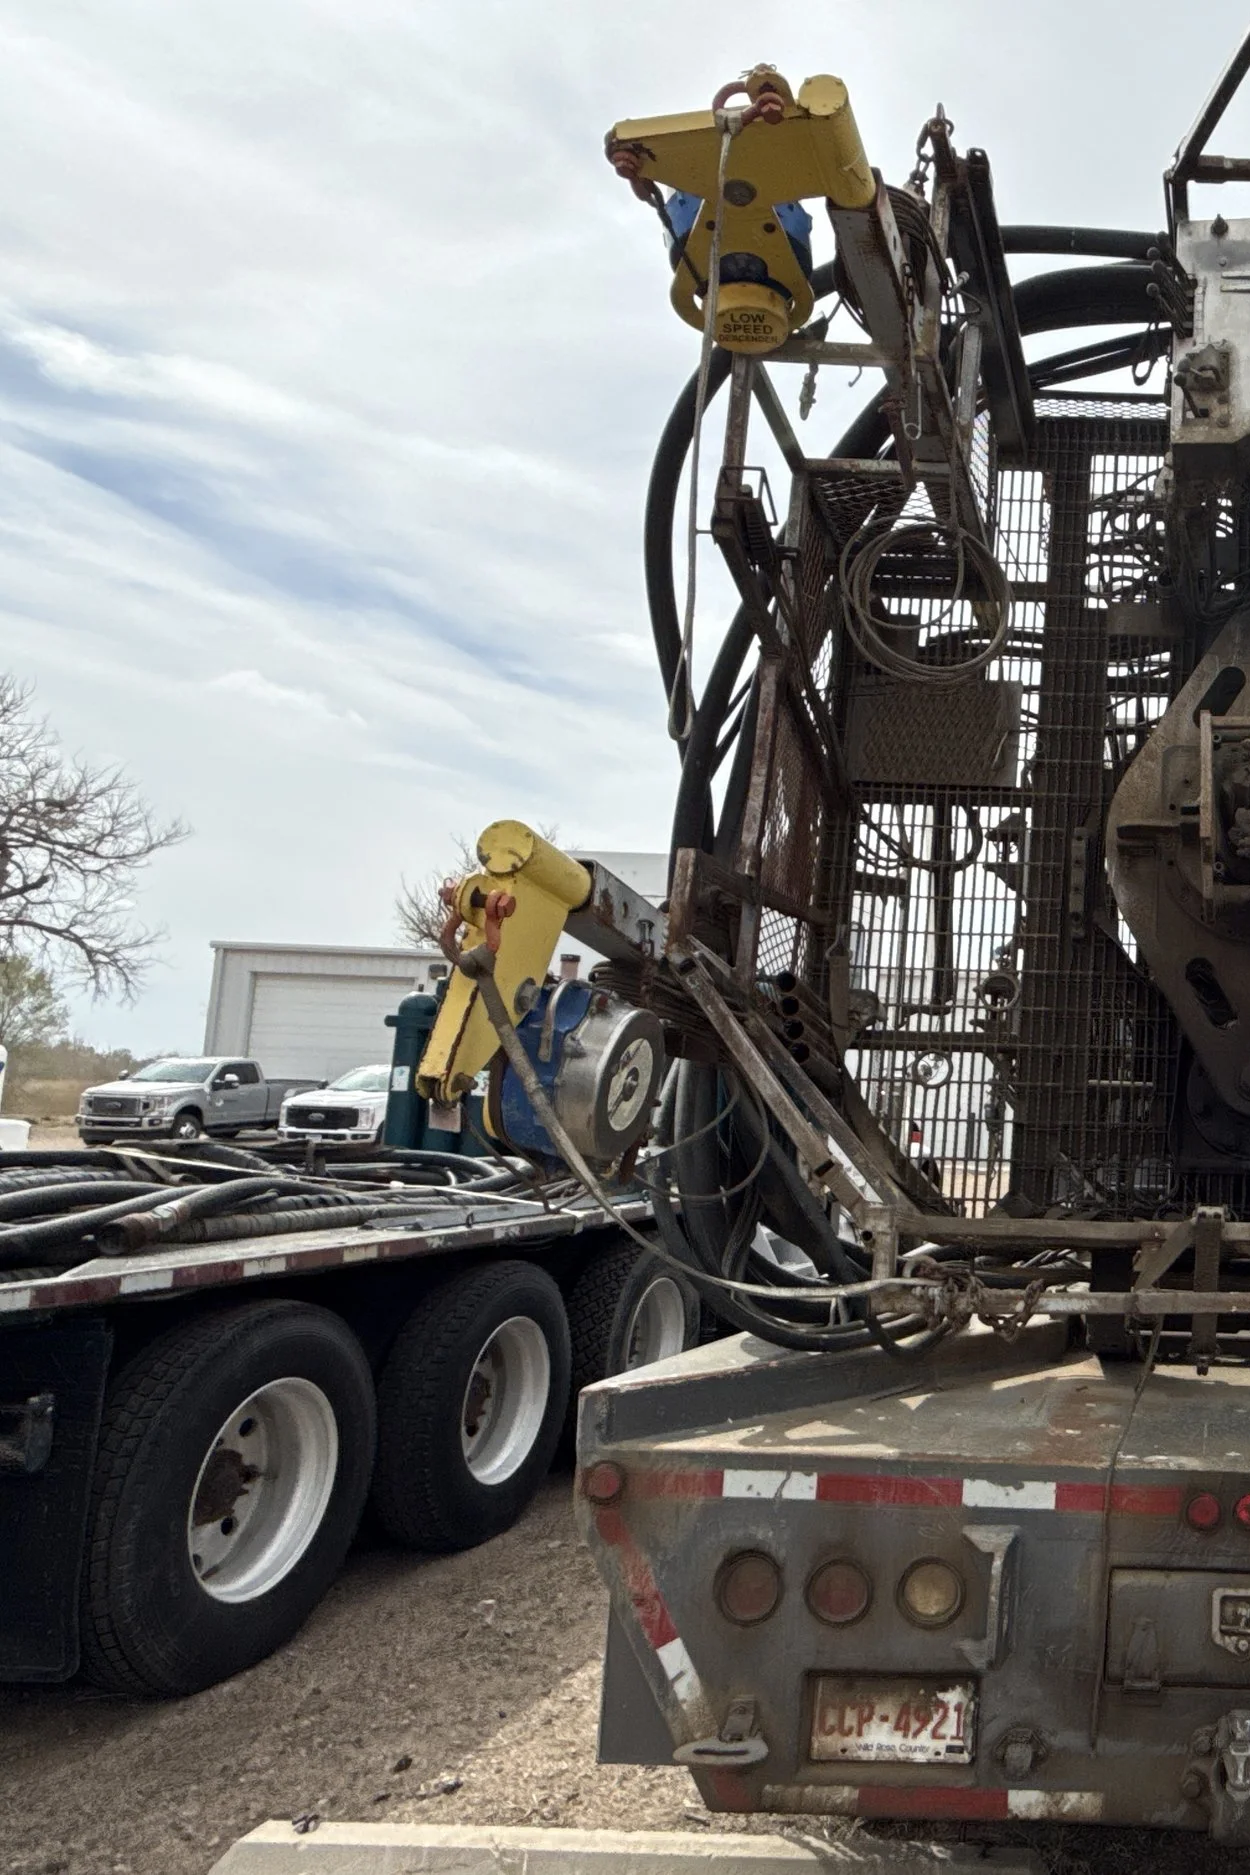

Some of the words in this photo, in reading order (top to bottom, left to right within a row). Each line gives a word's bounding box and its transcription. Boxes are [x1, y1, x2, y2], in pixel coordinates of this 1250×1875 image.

[730, 313, 765, 323] LOW
[722, 323, 773, 334] SPEED
[819, 1701, 965, 1741] CCP-4921
